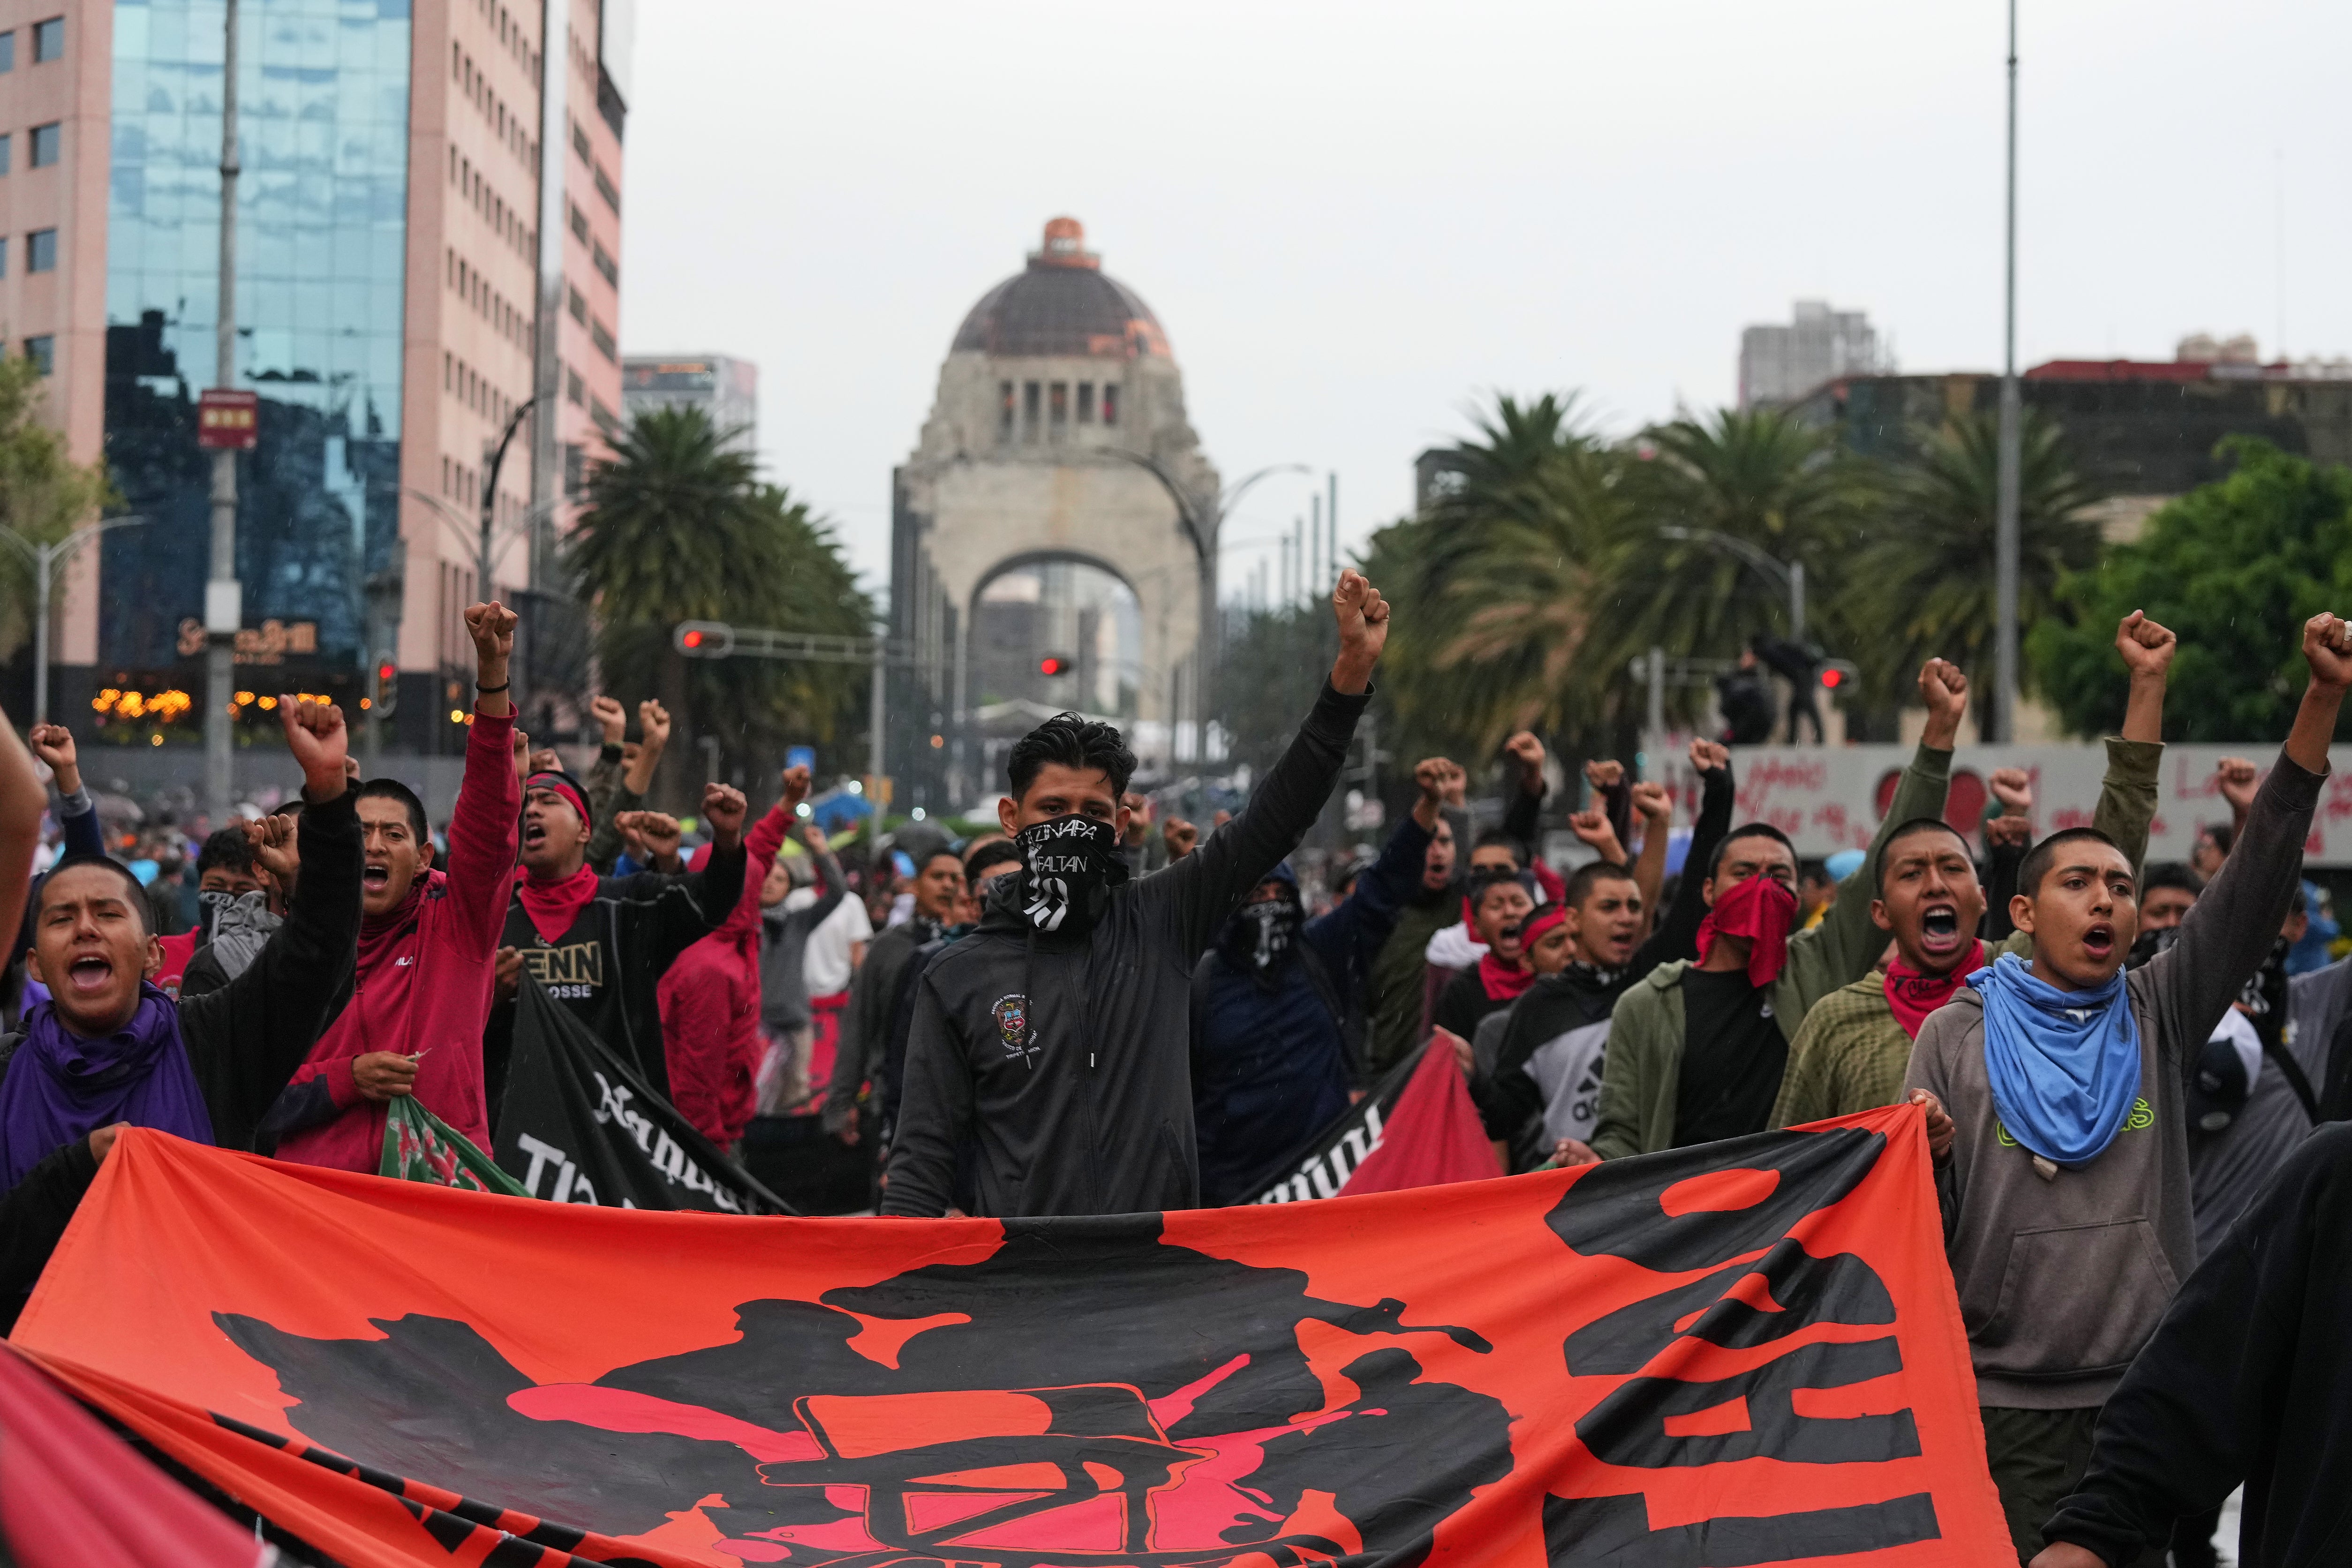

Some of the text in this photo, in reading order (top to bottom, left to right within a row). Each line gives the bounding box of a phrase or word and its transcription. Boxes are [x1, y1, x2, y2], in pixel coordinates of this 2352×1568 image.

[1037, 855, 1088, 873] FALTAN
[516, 940, 603, 987] ENN
[548, 985, 592, 999] OSSE
